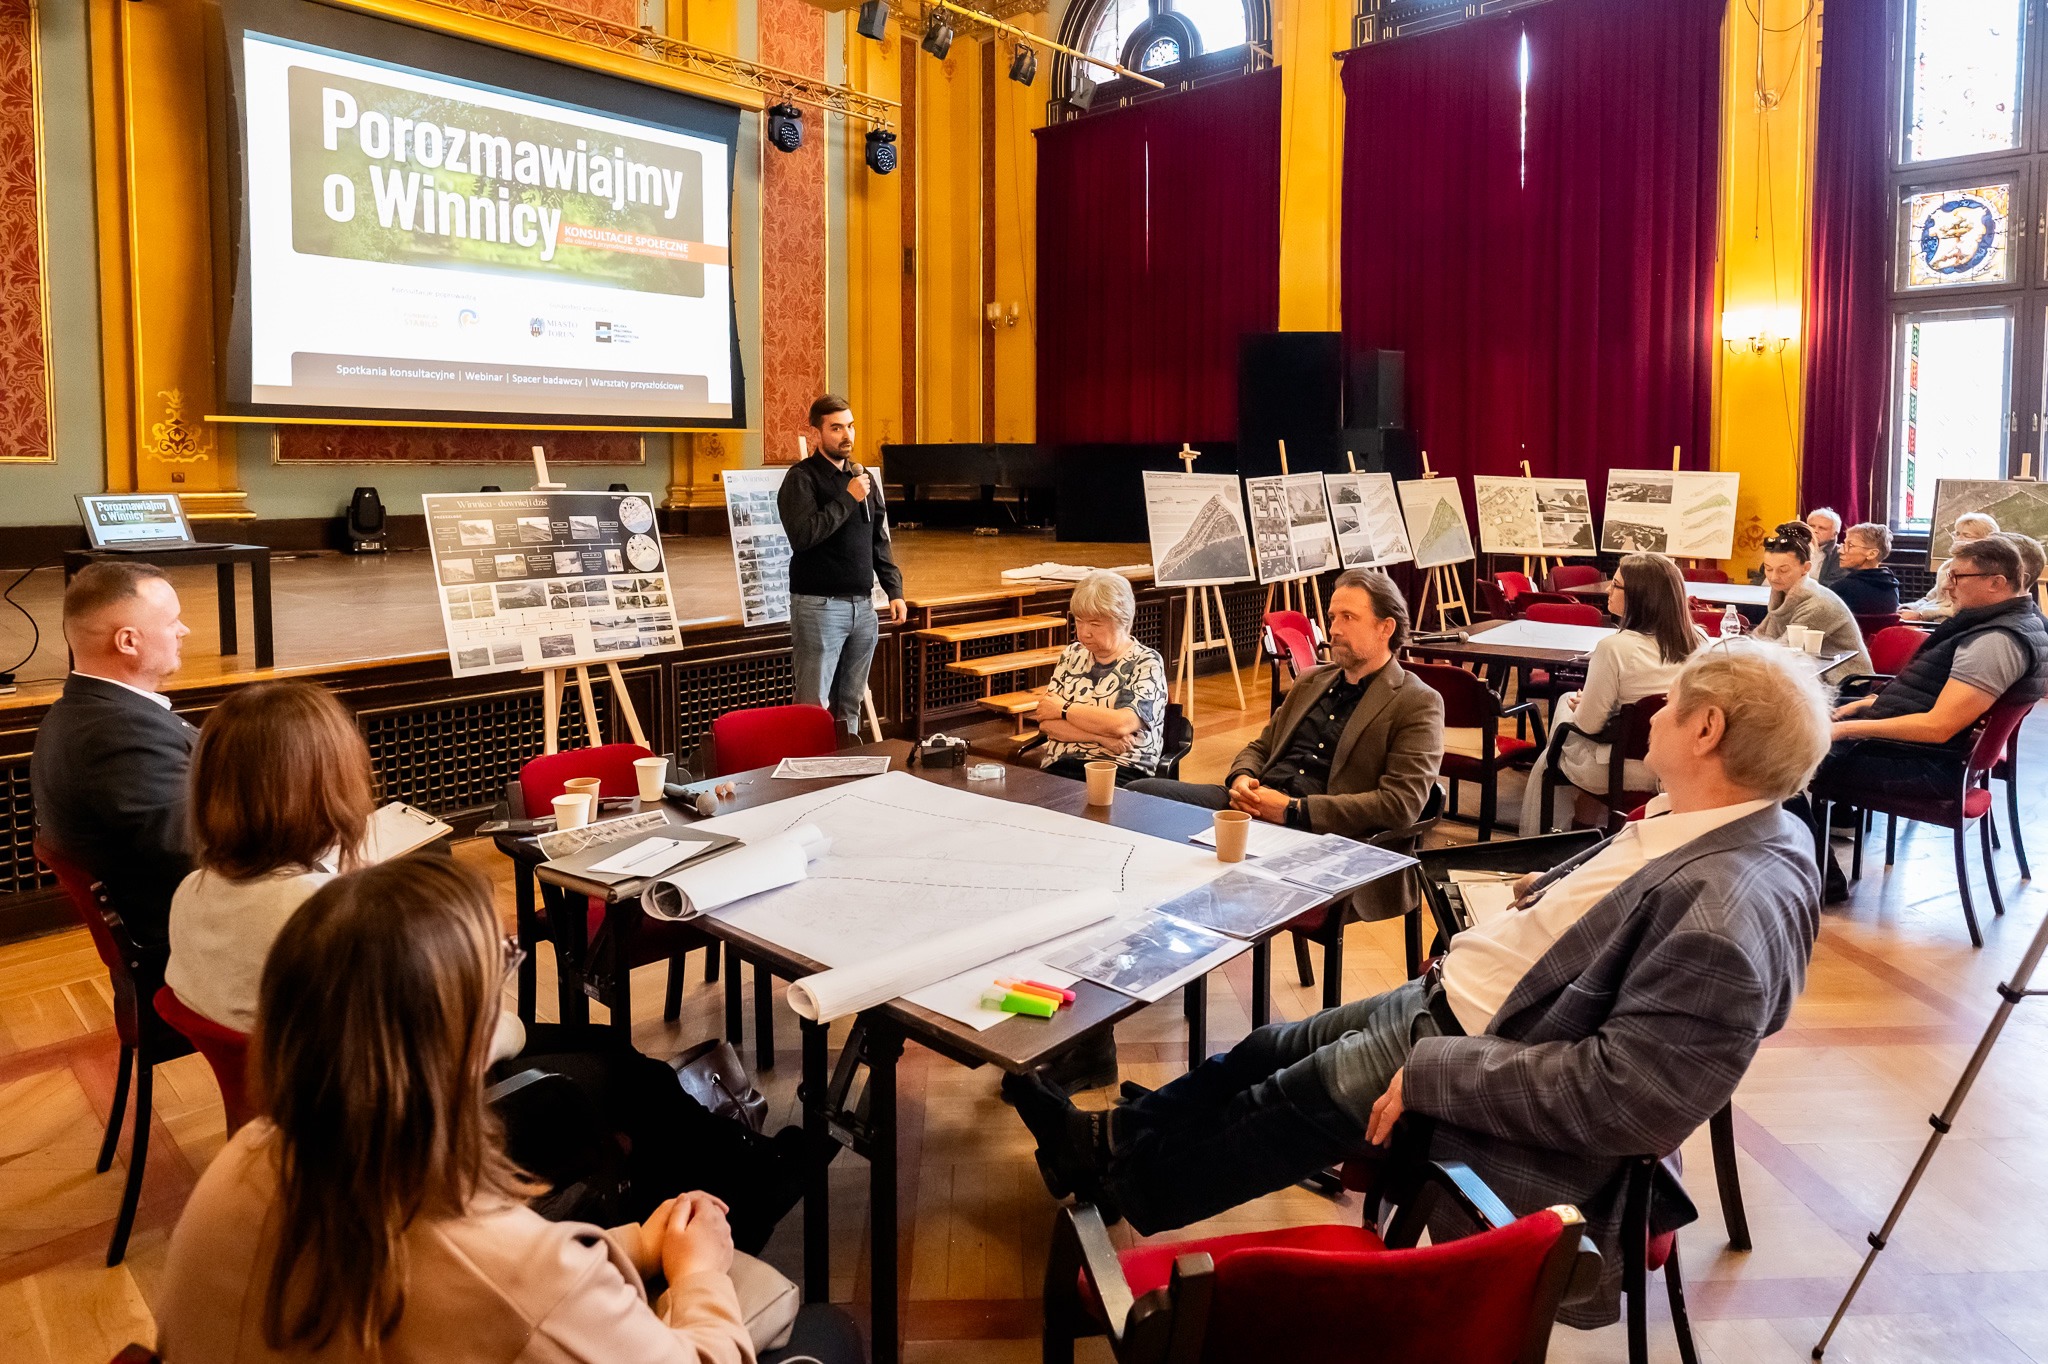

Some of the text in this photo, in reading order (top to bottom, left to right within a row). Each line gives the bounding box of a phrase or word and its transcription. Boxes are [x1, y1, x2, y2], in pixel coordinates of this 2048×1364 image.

[322, 87, 683, 219] Porozmawiajmy
[323, 165, 562, 261] o Winnicy
[564, 226, 689, 253] KONSULTACJE SPOŁECZNE
[547, 319, 578, 329] MIASTO
[336, 363, 685, 392] Spotkania konsultacyjne Webinar Spacer badawczy Warsztaty przyszłościowe
[96, 501, 167, 513] Porozmawiajmy
[532, 498, 548, 507] dziś
[100, 511, 145, 522] o Winnicy
